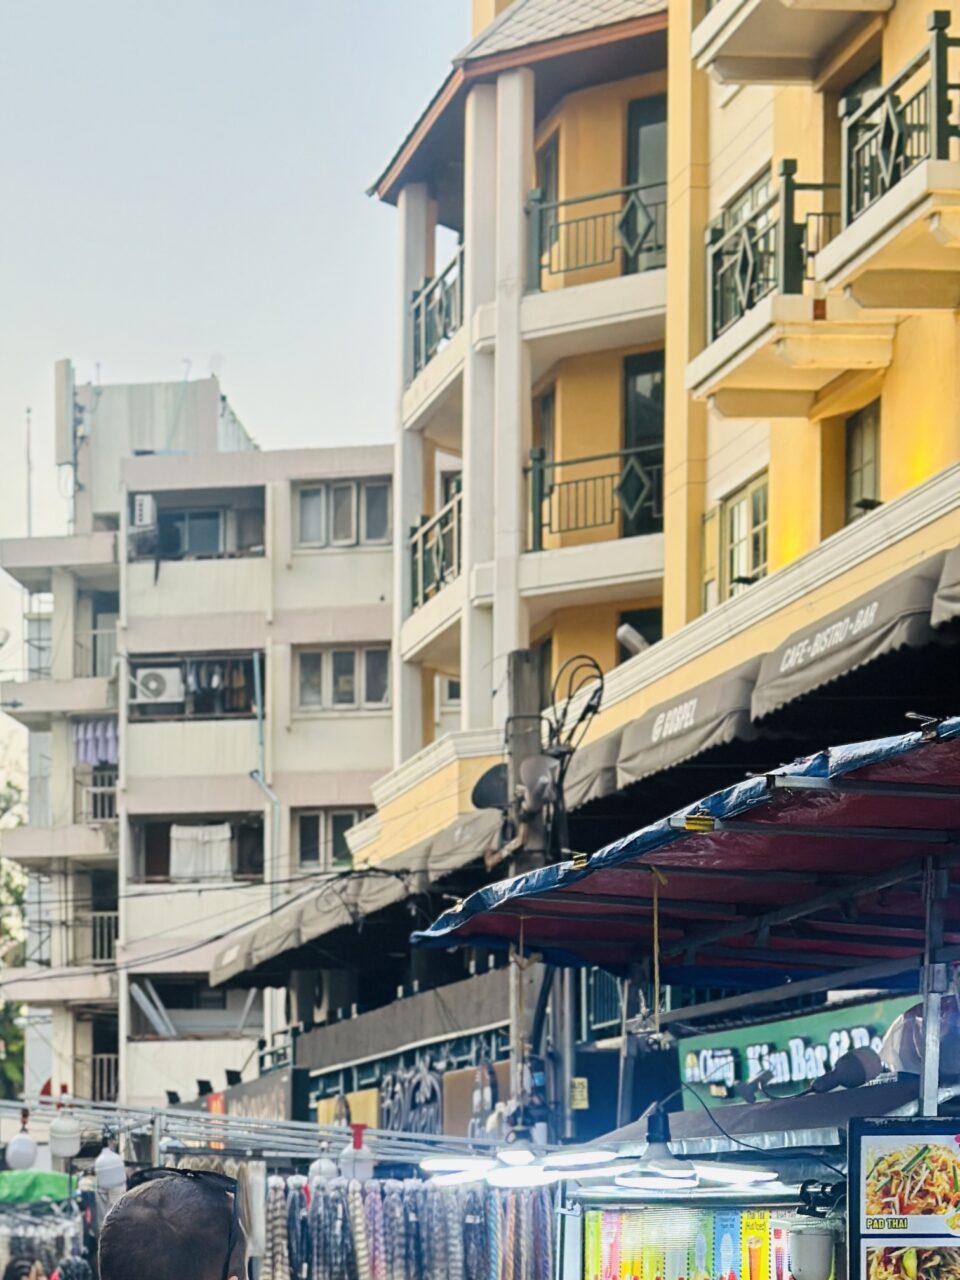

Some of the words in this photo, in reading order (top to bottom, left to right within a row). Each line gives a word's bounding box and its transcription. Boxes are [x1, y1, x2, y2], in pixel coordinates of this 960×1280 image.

[789, 1038, 828, 1080] Bar
[866, 1218, 886, 1230] PAD
[887, 1218, 908, 1230] THAI
